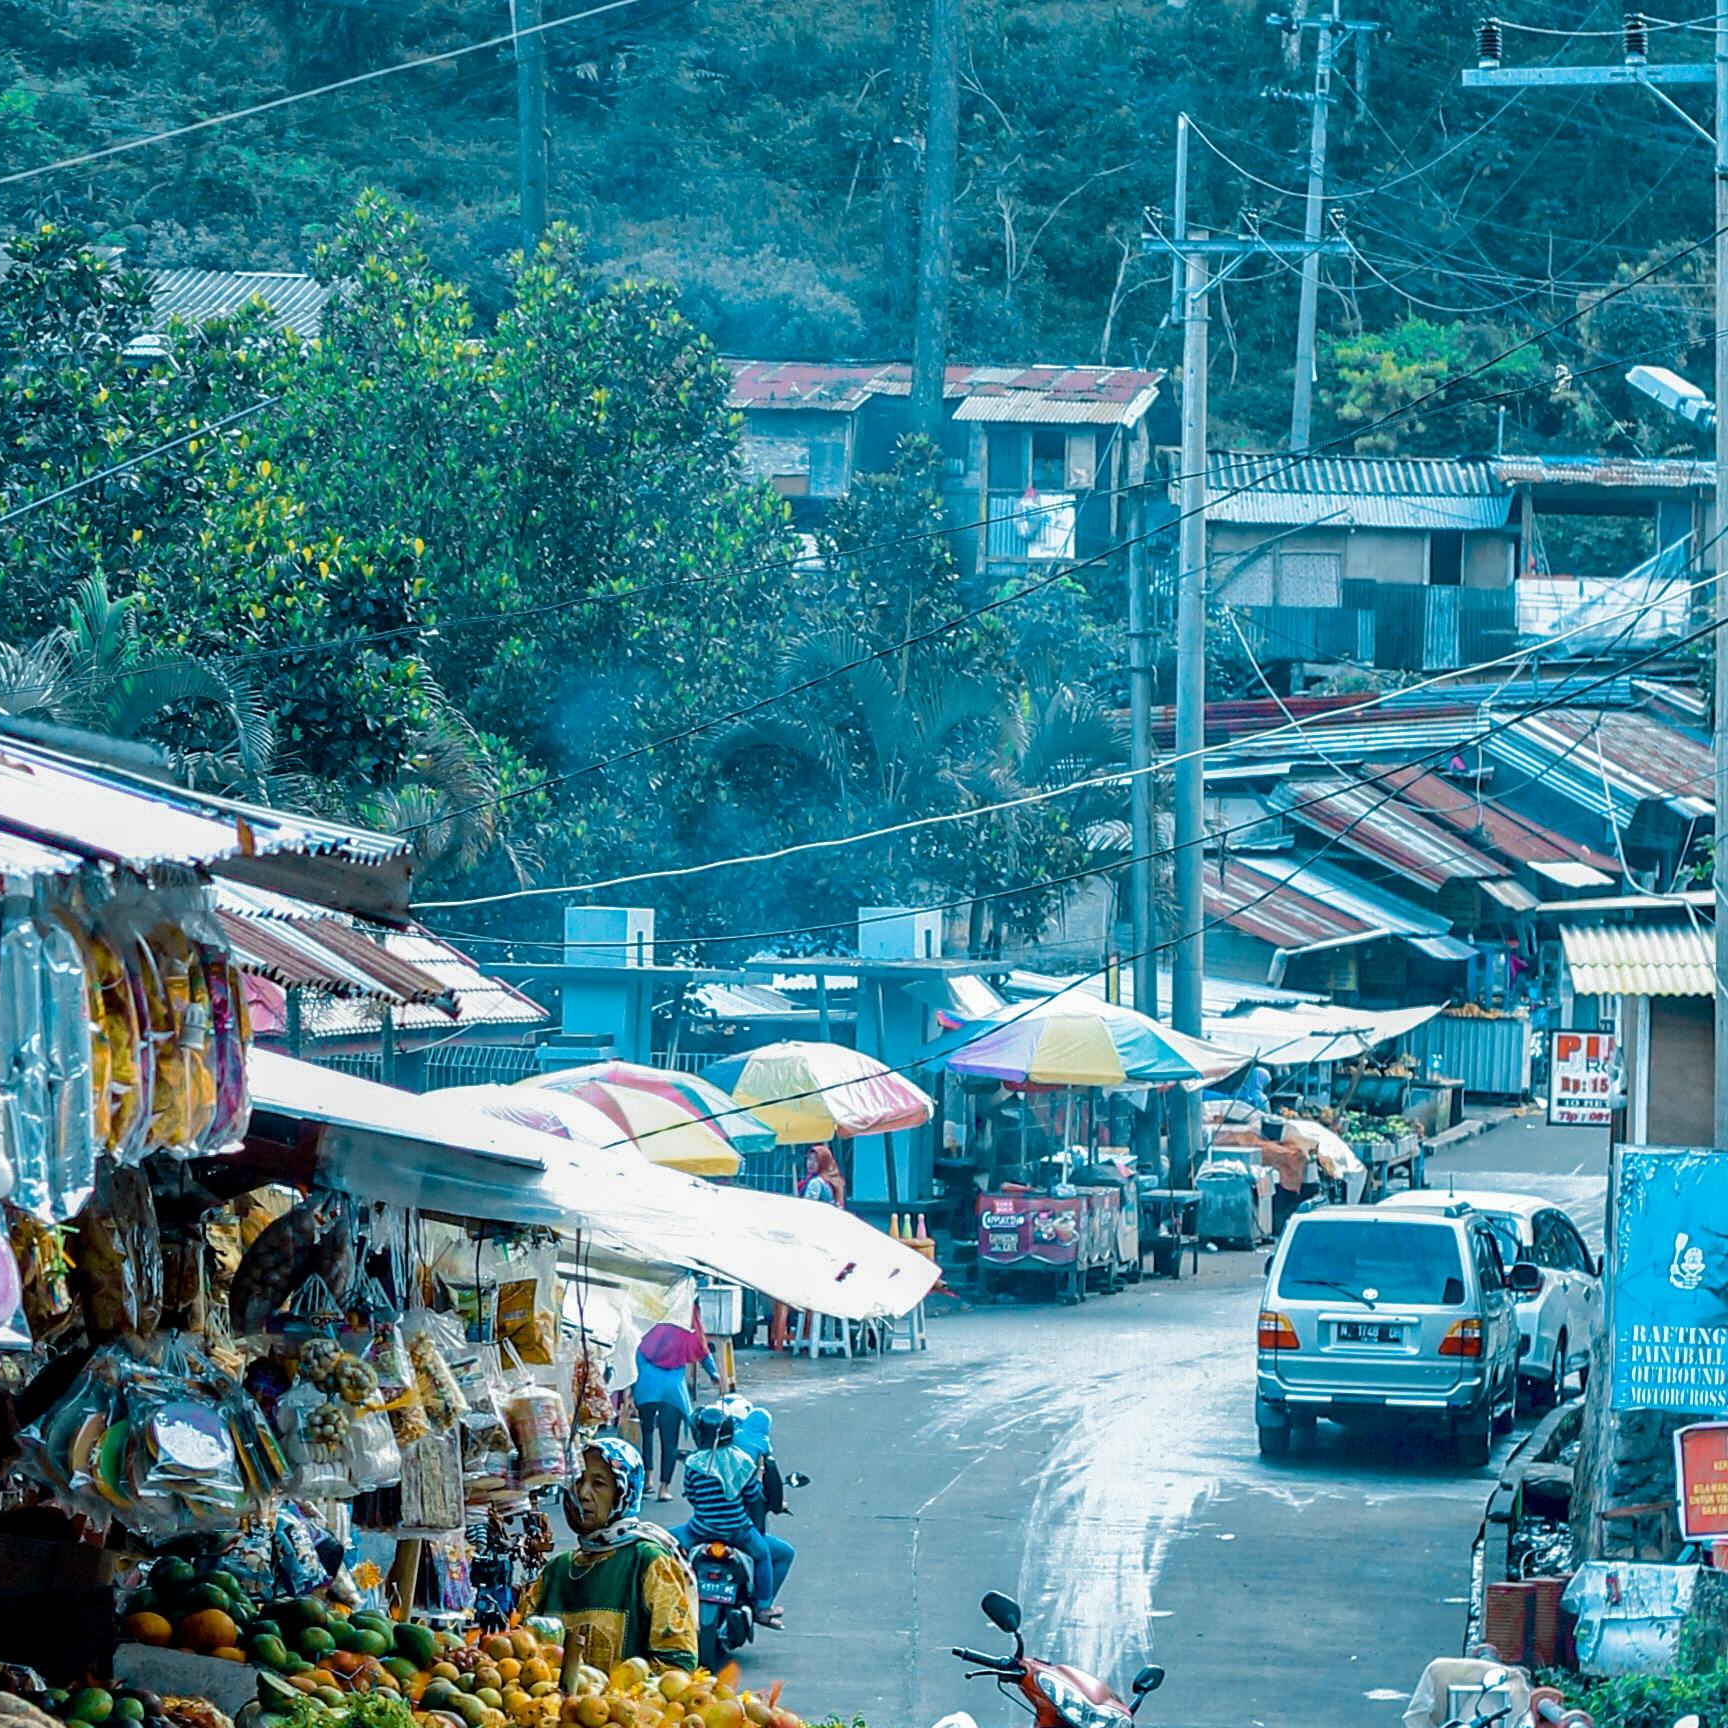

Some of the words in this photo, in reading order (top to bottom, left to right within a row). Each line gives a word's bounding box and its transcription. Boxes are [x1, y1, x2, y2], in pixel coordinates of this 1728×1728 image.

[1633, 1324, 1727, 1345] RAFTING
[1632, 1344, 1726, 1365] PAINTBALL
[1631, 1365, 1726, 1386] OUTBOUND
[1630, 1386, 1728, 1407] MOTORCROSS
